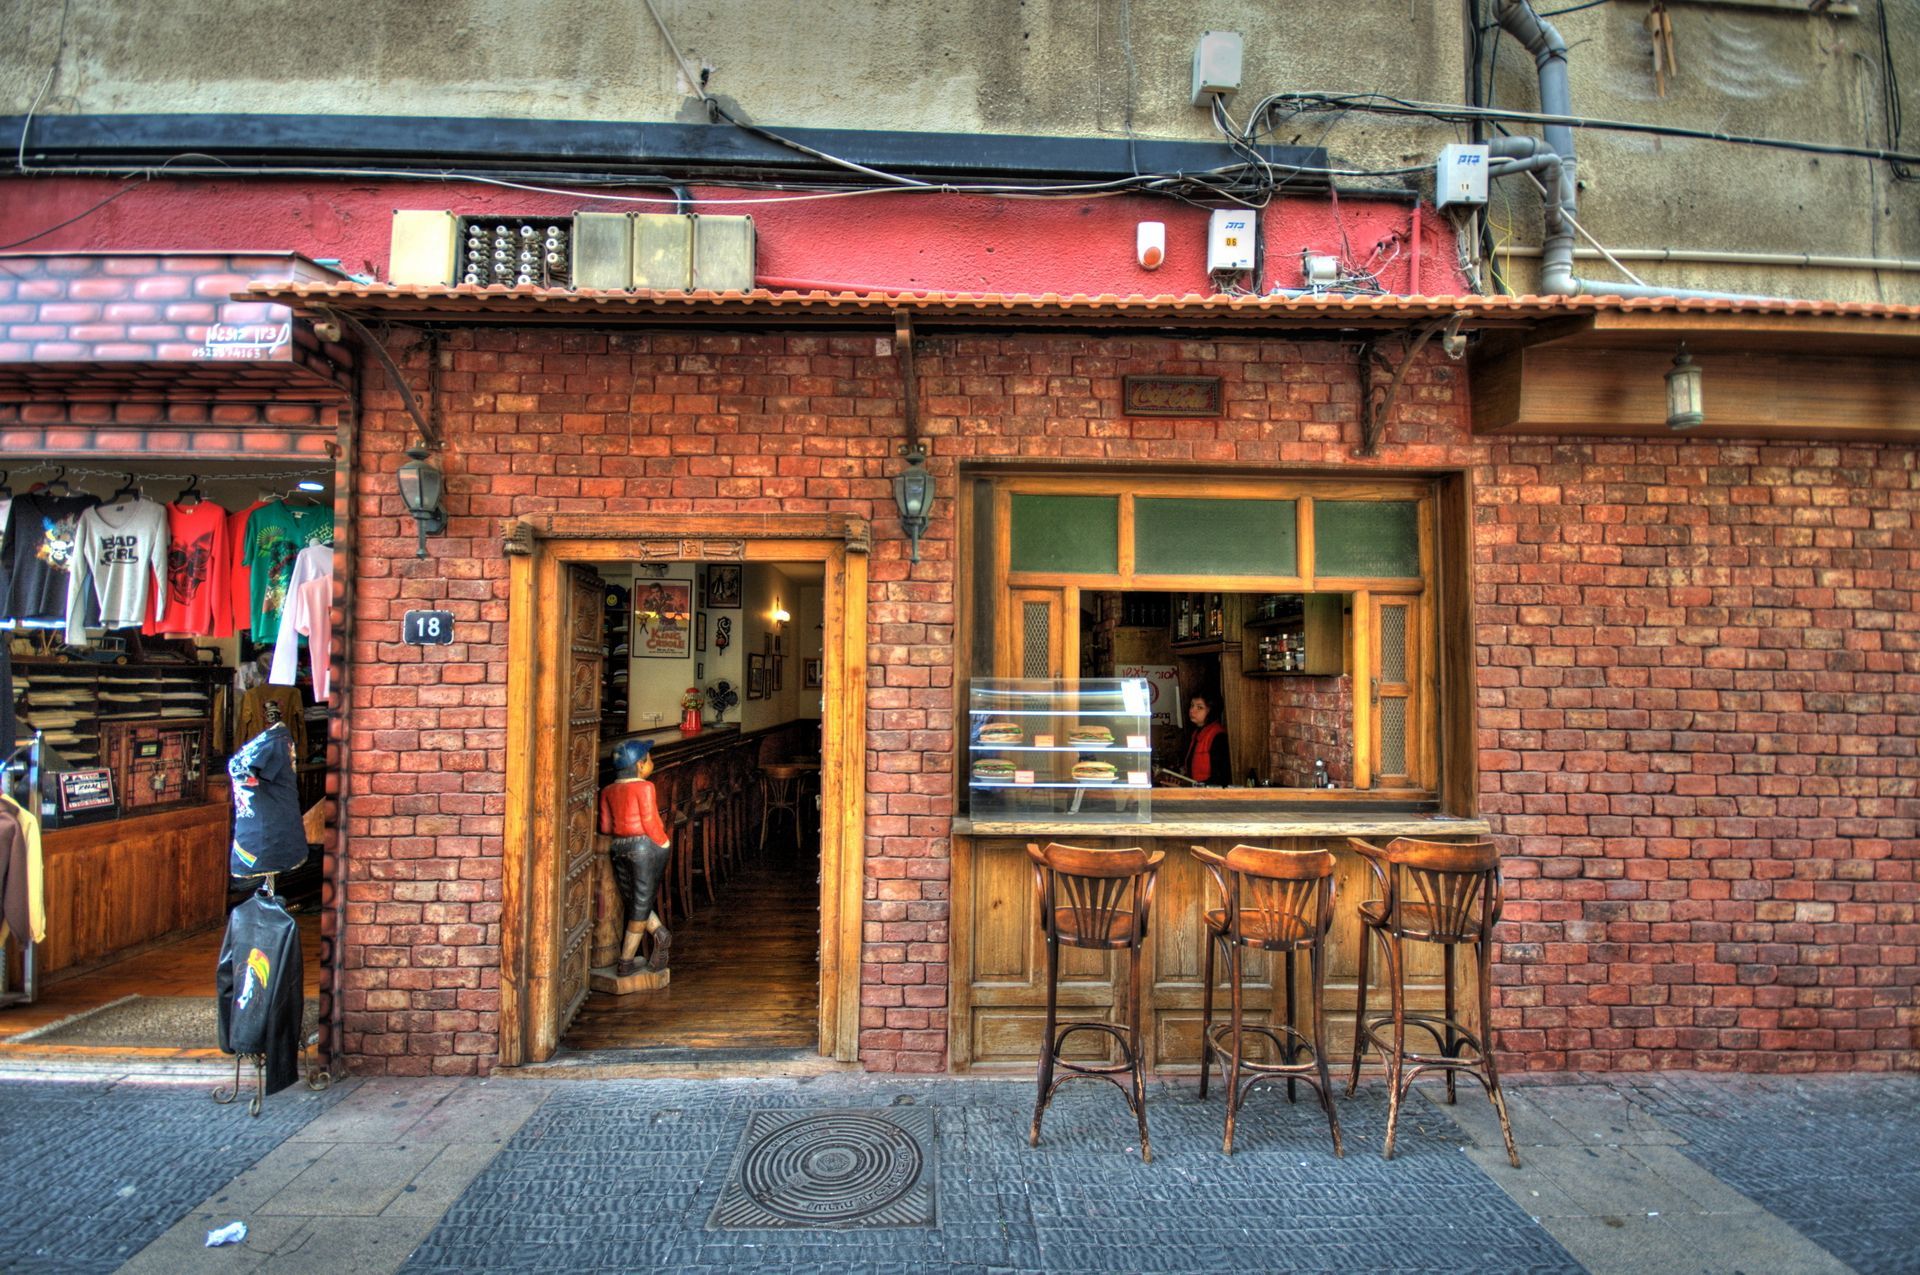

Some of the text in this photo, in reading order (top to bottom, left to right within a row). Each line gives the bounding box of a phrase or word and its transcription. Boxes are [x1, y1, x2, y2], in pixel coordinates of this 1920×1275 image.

[1457, 154, 1481, 165] בזק
[1225, 221, 1246, 229] בזק
[100, 534, 138, 550] BAD
[416, 617, 440, 637] 18
